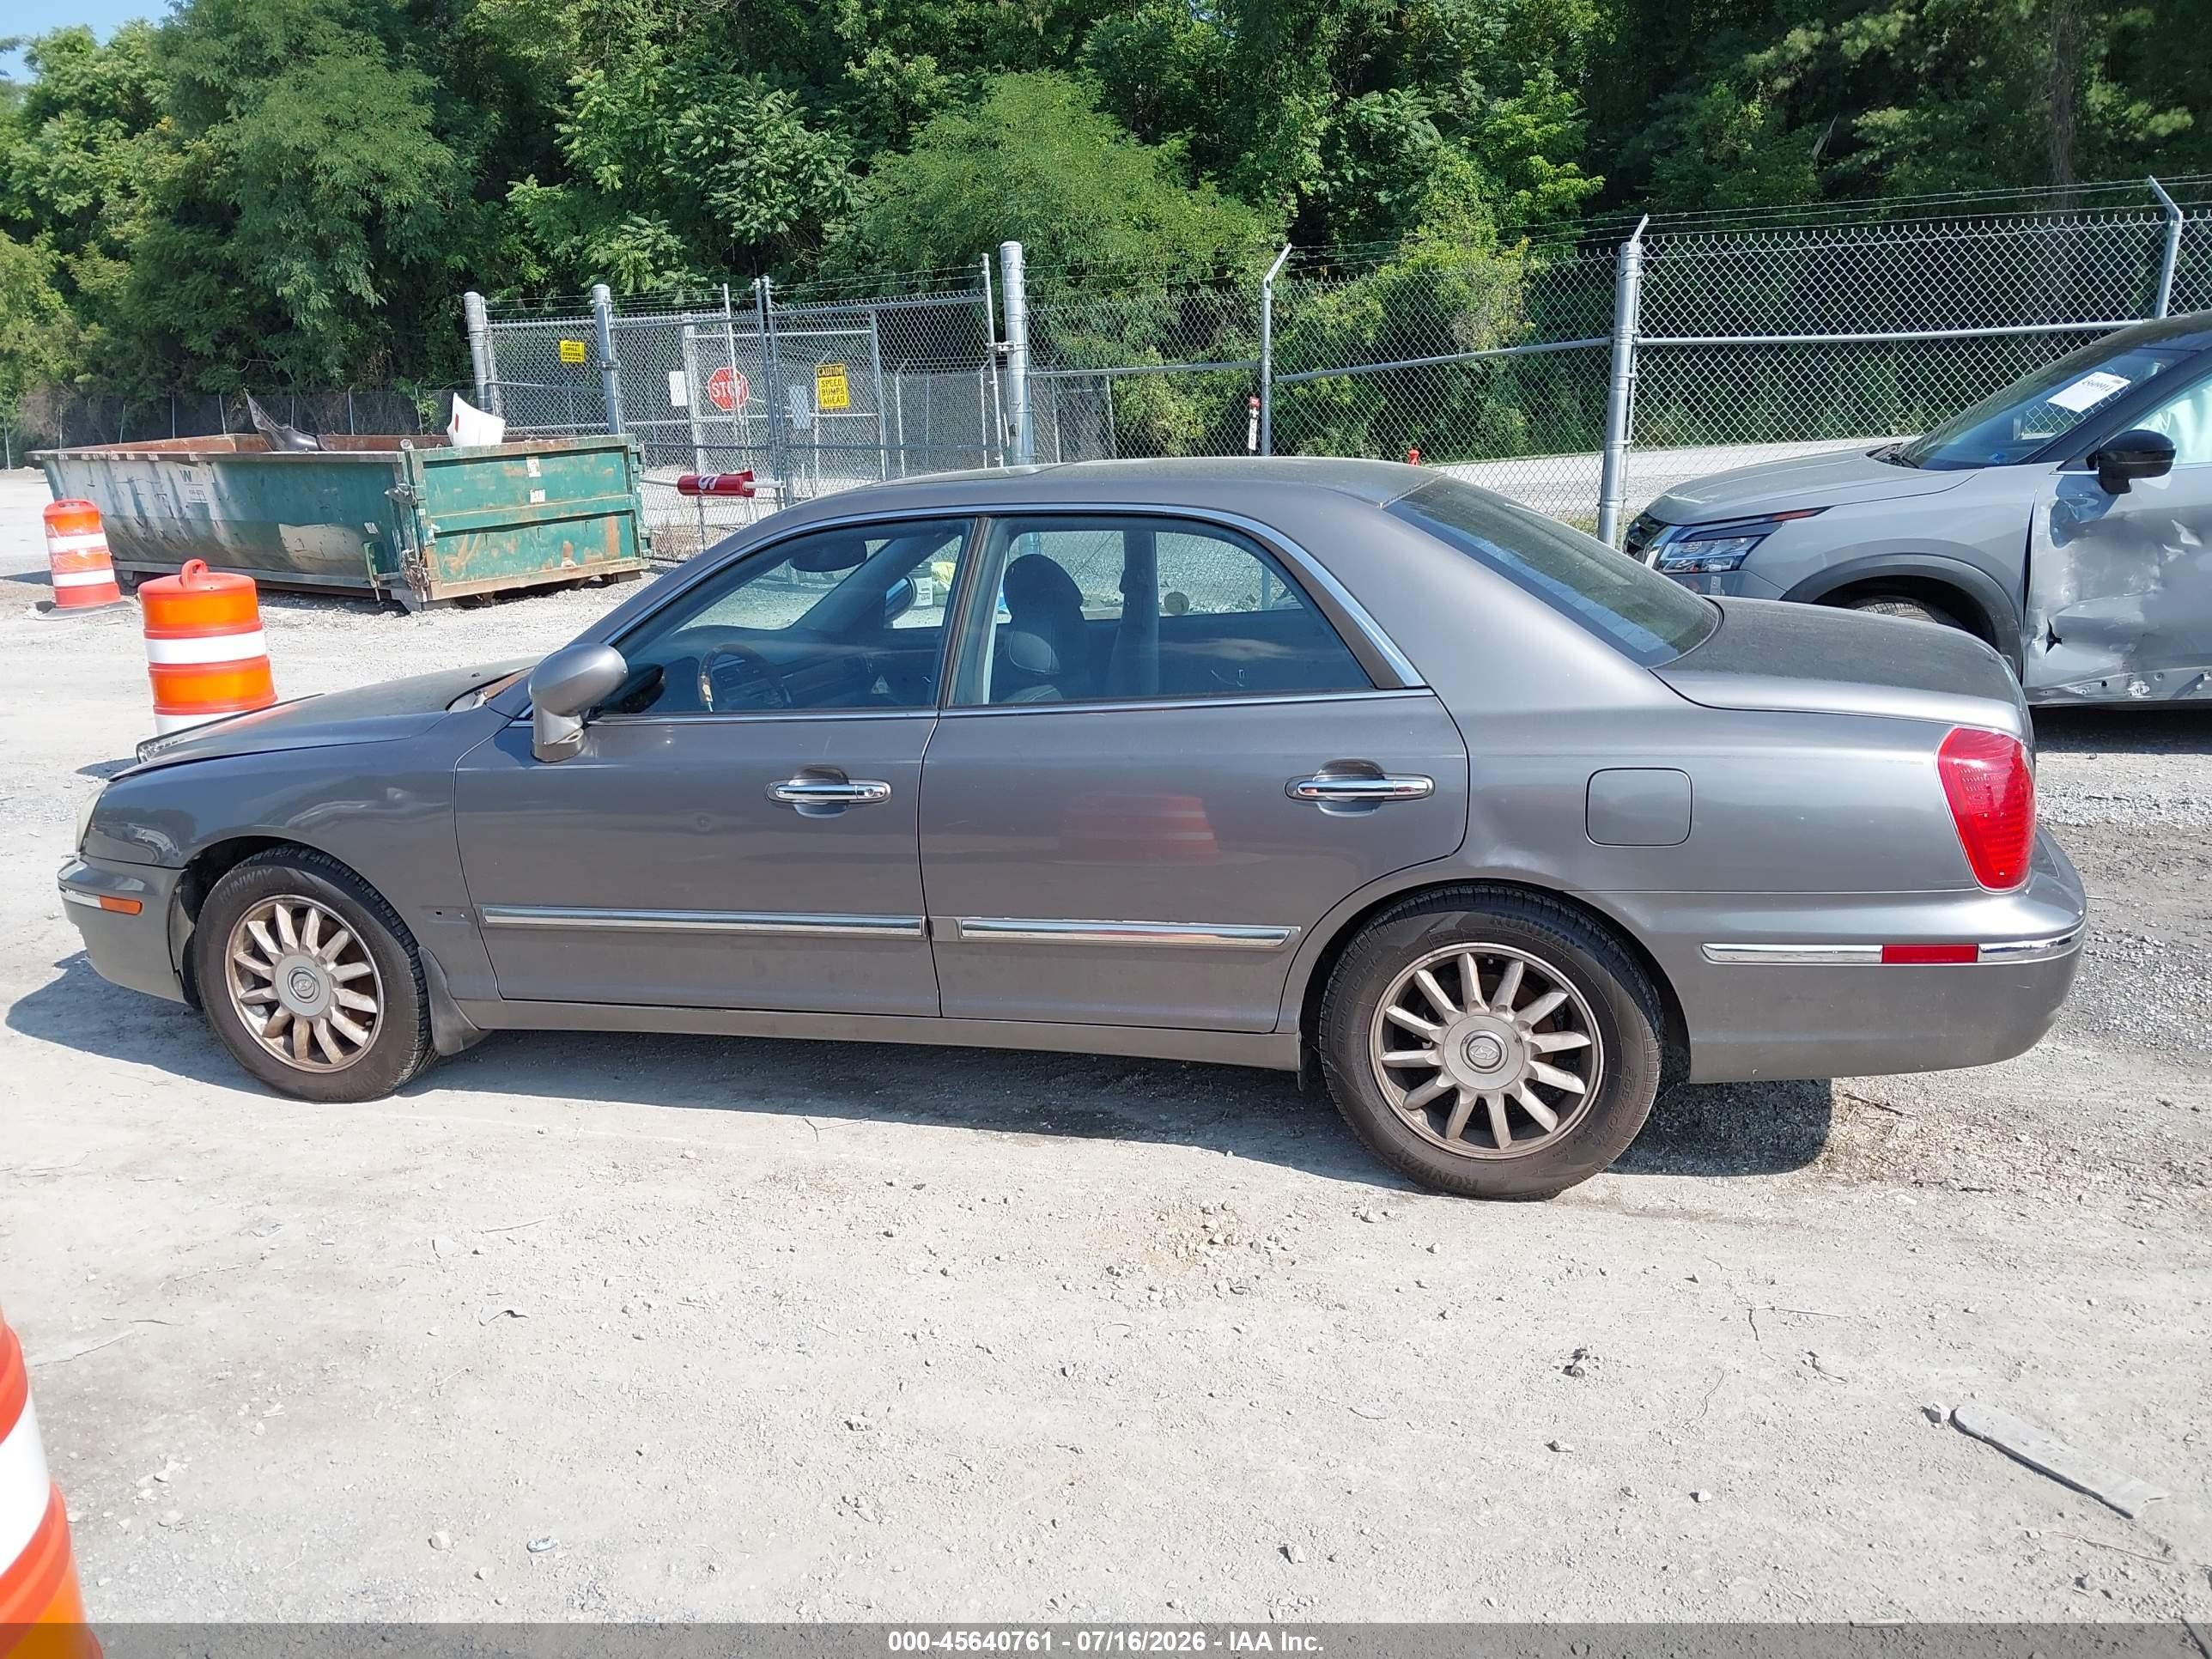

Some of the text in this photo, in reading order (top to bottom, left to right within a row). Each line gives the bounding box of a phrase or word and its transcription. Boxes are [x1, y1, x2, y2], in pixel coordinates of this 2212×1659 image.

[817, 366, 844, 377] CAUTION
[820, 377, 843, 387] SPEED
[821, 386, 845, 396] BUMPS
[822, 395, 846, 405] AHEAD
